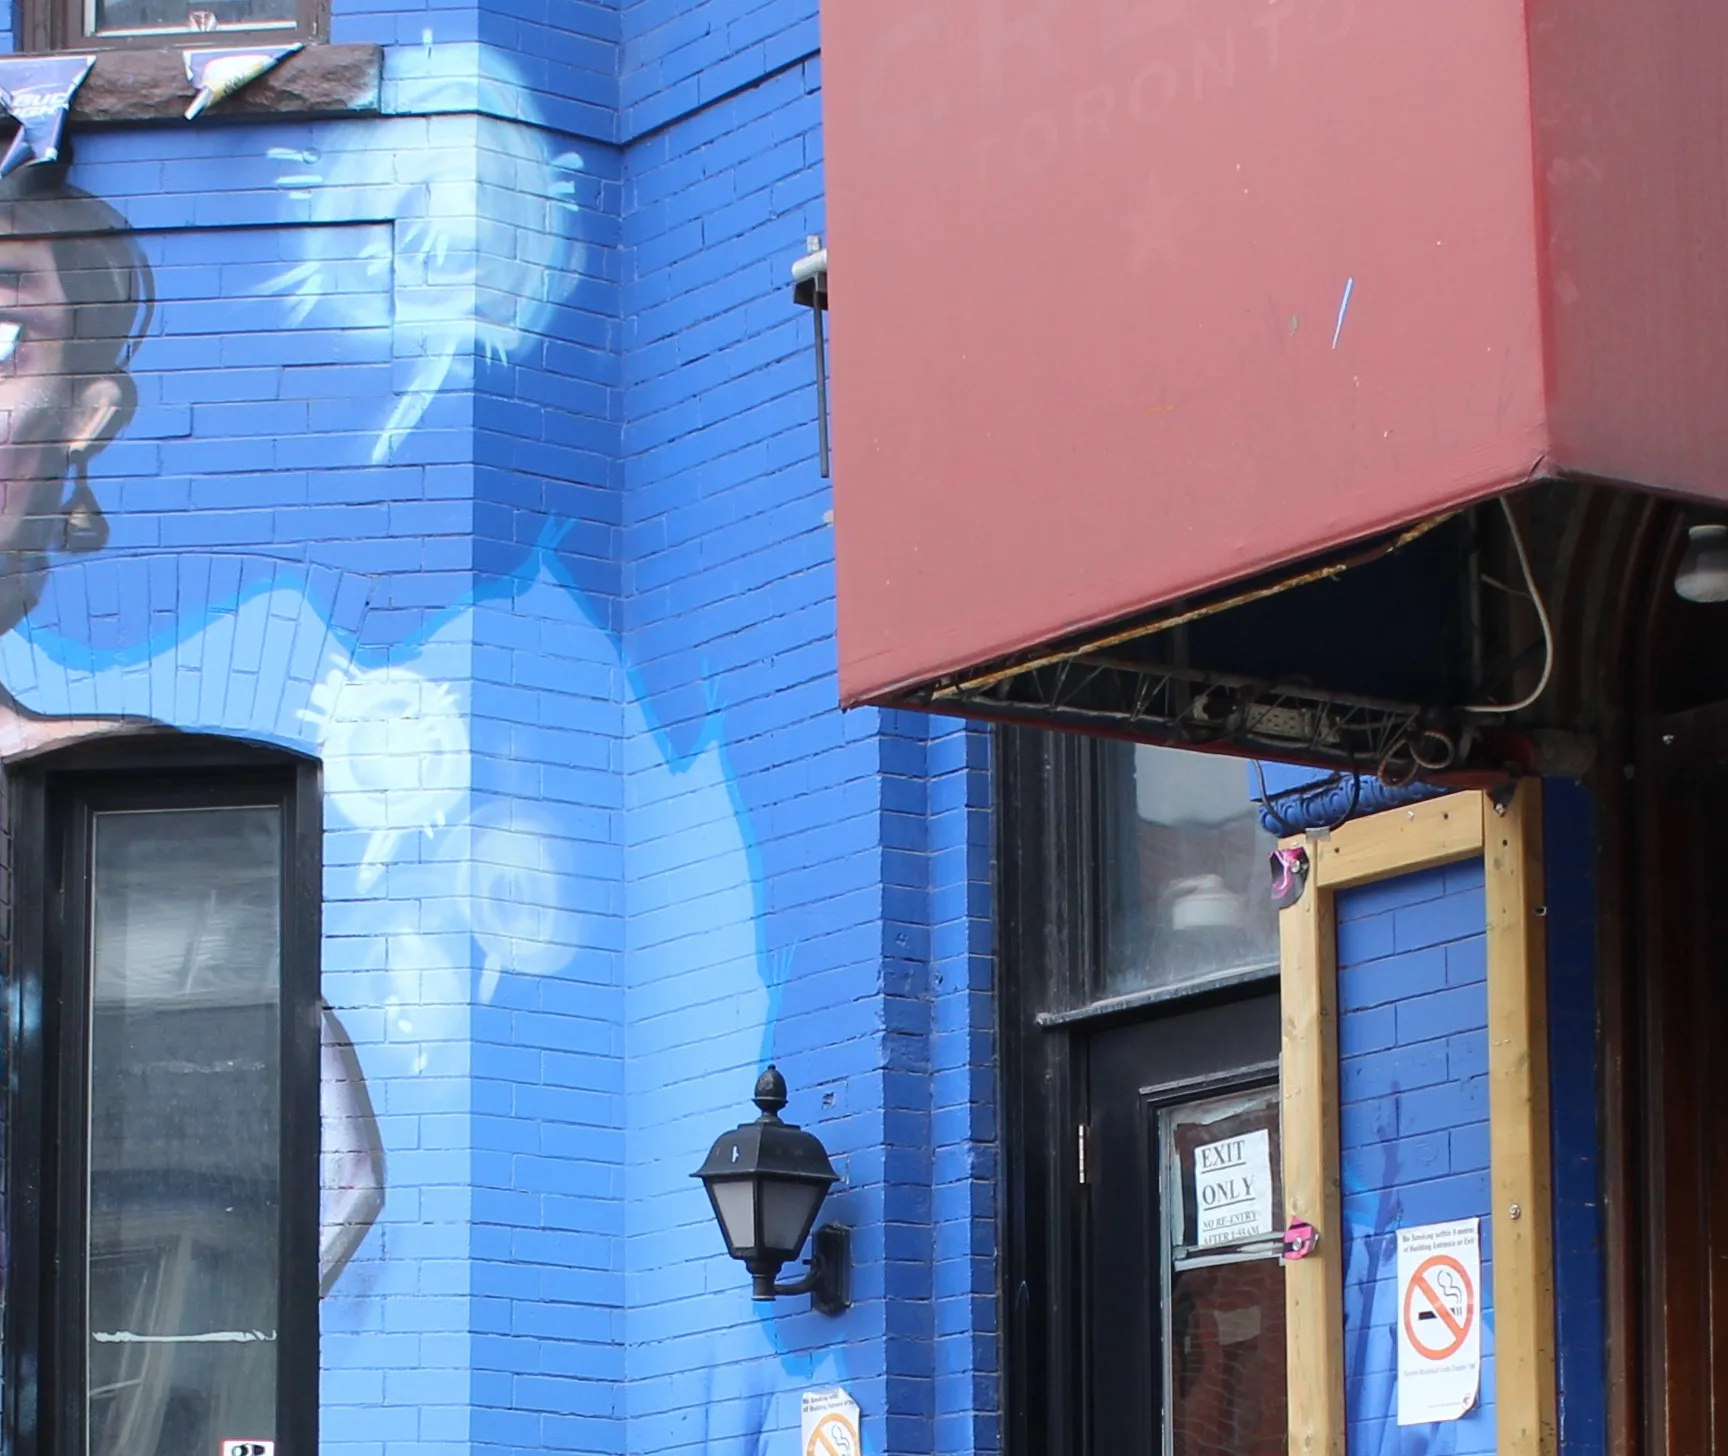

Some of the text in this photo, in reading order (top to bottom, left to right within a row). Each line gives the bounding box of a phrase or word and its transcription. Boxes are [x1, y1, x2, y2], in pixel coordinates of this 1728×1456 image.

[1201, 1140, 1246, 1169] EXIT
[1202, 1175, 1254, 1206] ONLY
[1203, 1218, 1215, 1229] NO
[1203, 1231, 1229, 1246] AFTER
